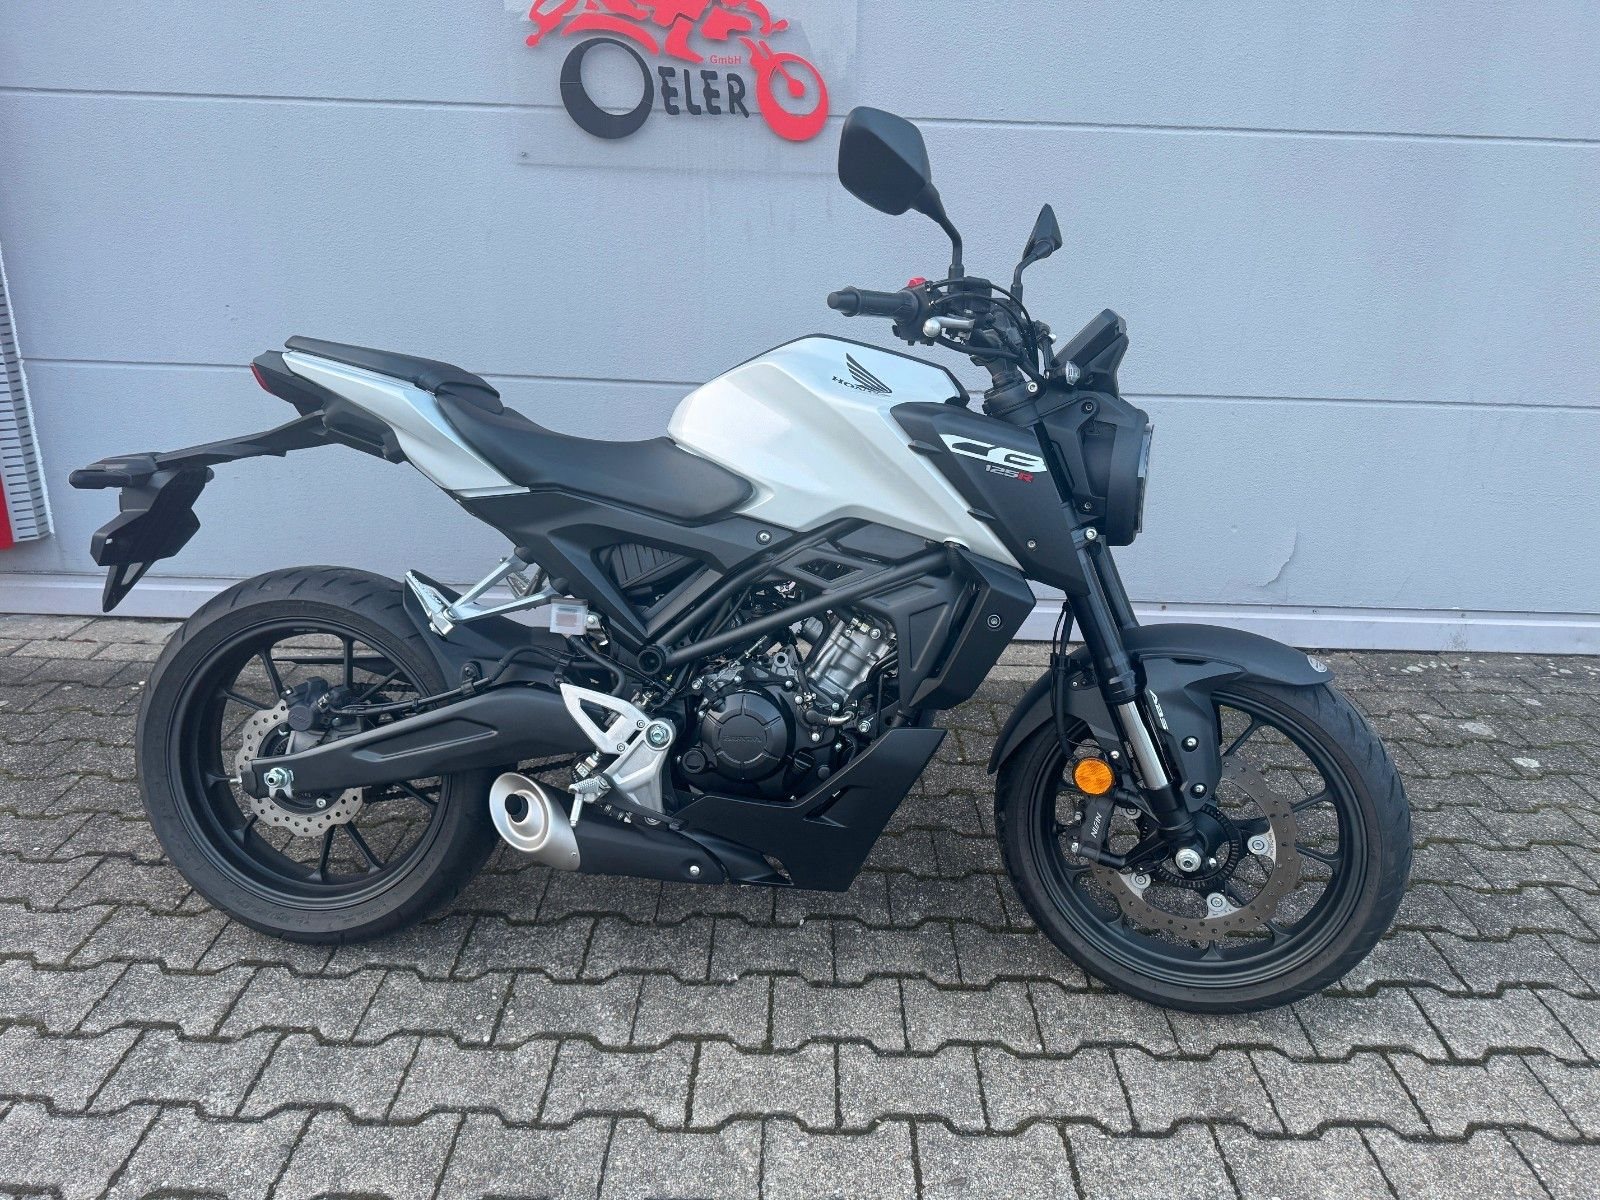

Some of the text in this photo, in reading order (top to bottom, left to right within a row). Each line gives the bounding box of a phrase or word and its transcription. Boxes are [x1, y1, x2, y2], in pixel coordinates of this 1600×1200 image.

[710, 55, 742, 65] GmbH
[560, 37, 749, 139] OELER
[985, 464, 1034, 483] 125R
[1149, 689, 1168, 730] ABS
